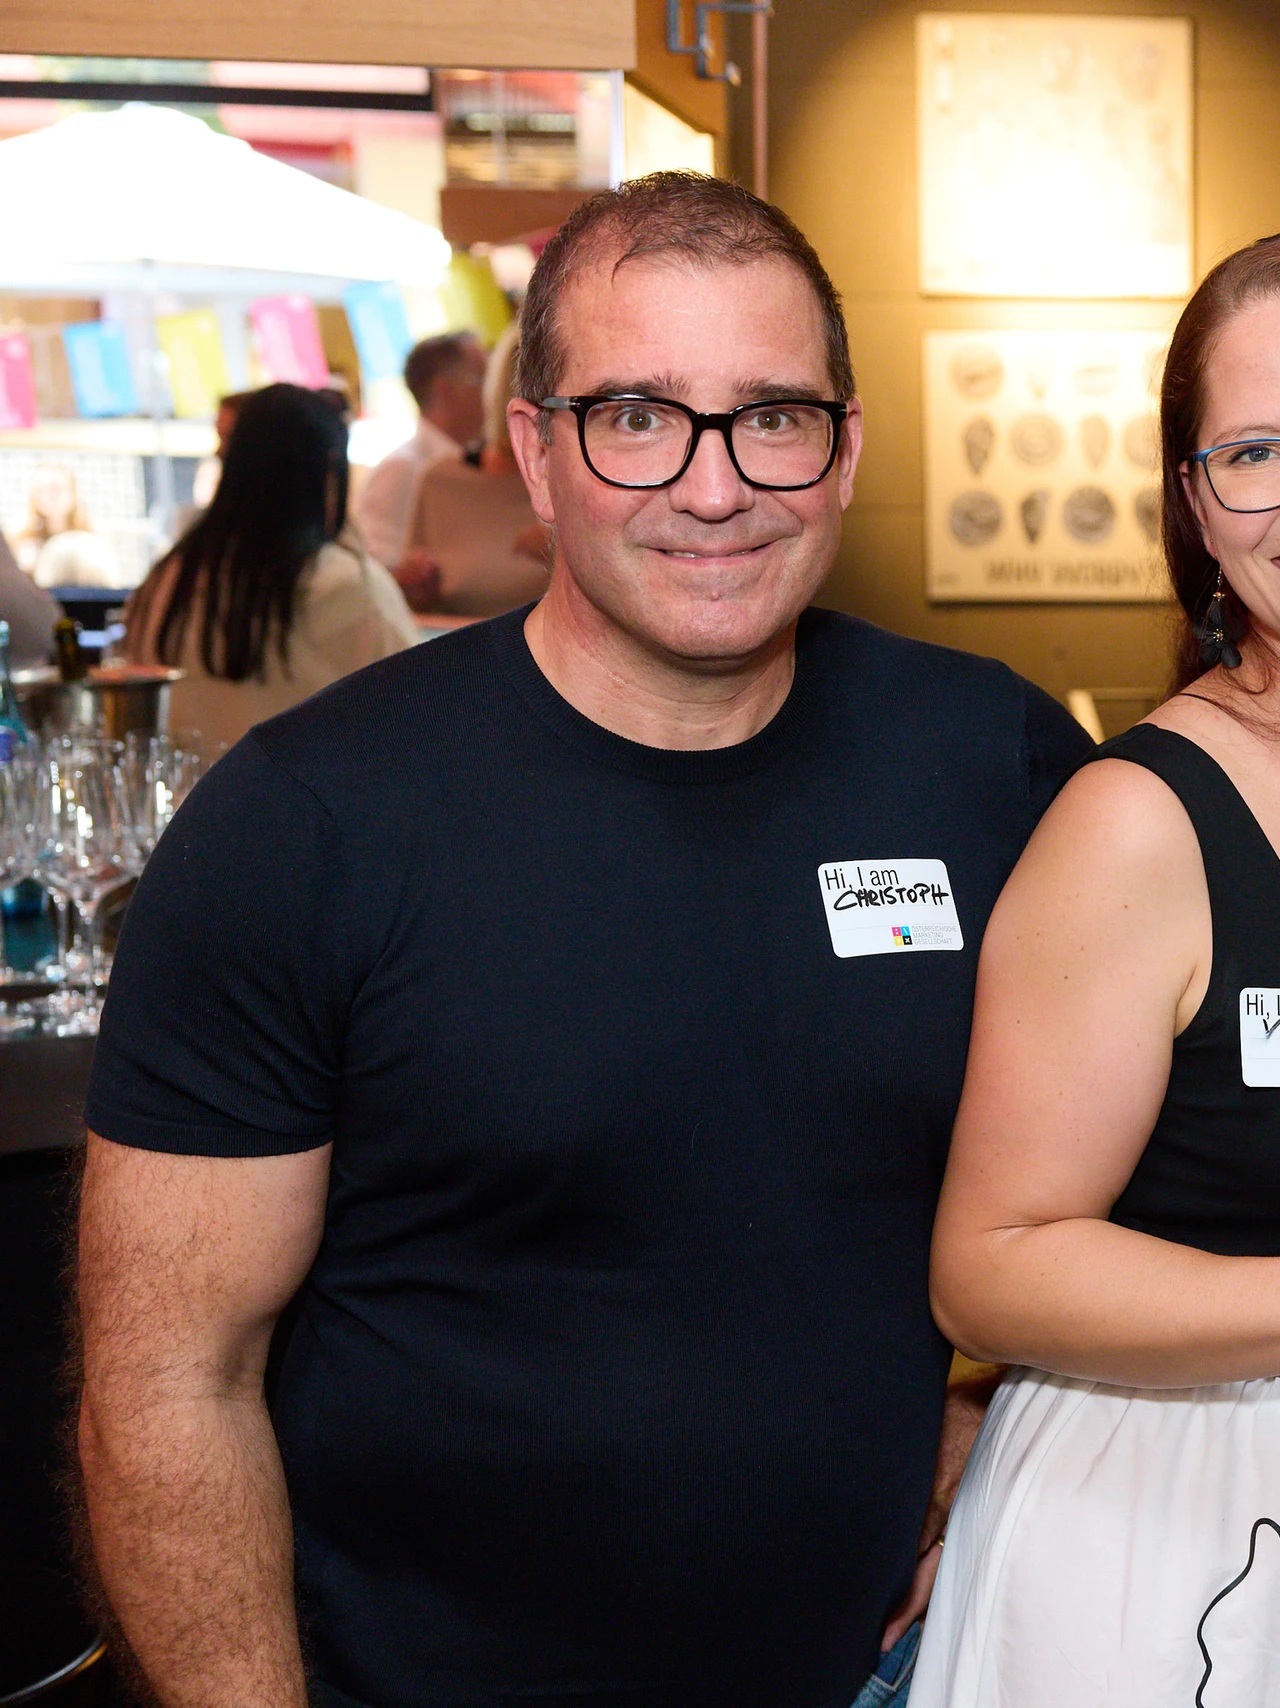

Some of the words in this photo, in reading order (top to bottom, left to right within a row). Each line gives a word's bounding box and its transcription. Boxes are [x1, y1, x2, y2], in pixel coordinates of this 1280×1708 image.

[825, 868, 852, 891] Hi,
[857, 866, 863, 887] I
[870, 869, 899, 886] am
[833, 883, 949, 911] CHRISTOPH
[913, 931, 944, 939] MARKETING
[1246, 993, 1270, 1020] Hi,
[1277, 994, 1280, 1016] I
